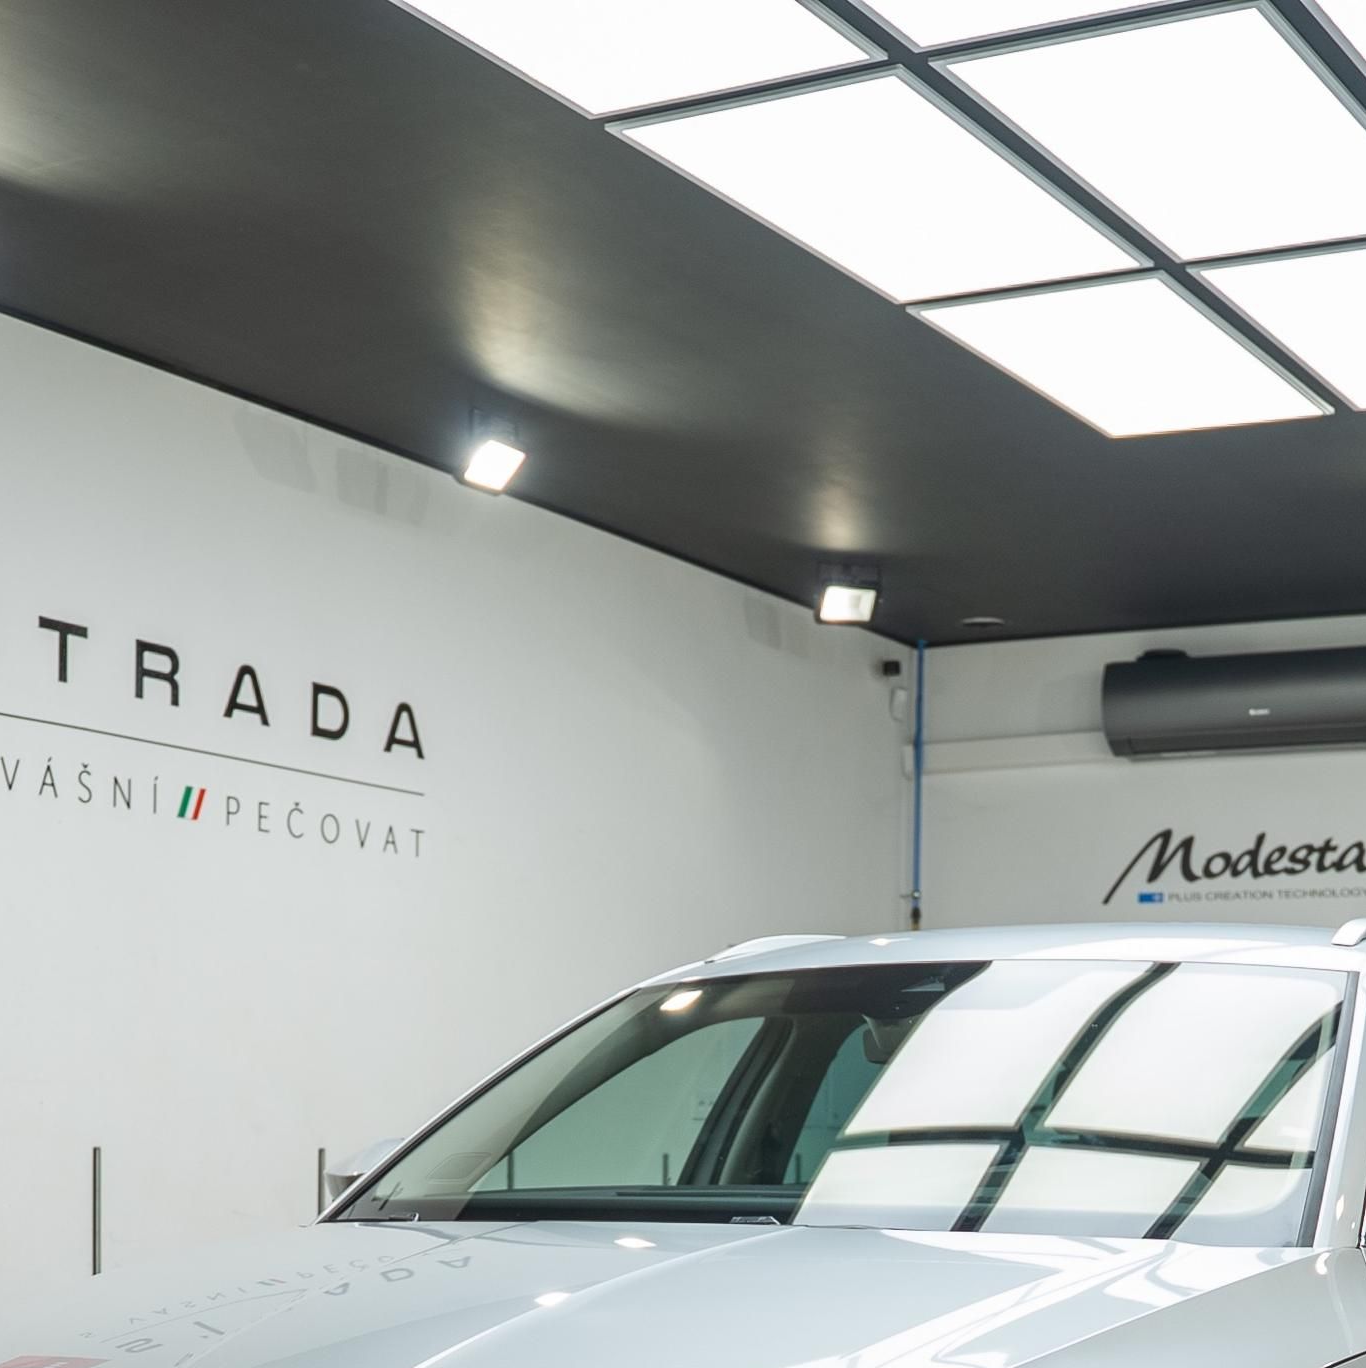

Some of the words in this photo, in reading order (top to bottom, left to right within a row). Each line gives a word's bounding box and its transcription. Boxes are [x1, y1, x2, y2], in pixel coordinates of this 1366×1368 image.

[0, 756, 159, 815] VÁŠNÍ
[225, 796, 425, 857] PEČOVAT
[1167, 890, 1202, 903] PLUS
[1204, 887, 1273, 901] CREATION
